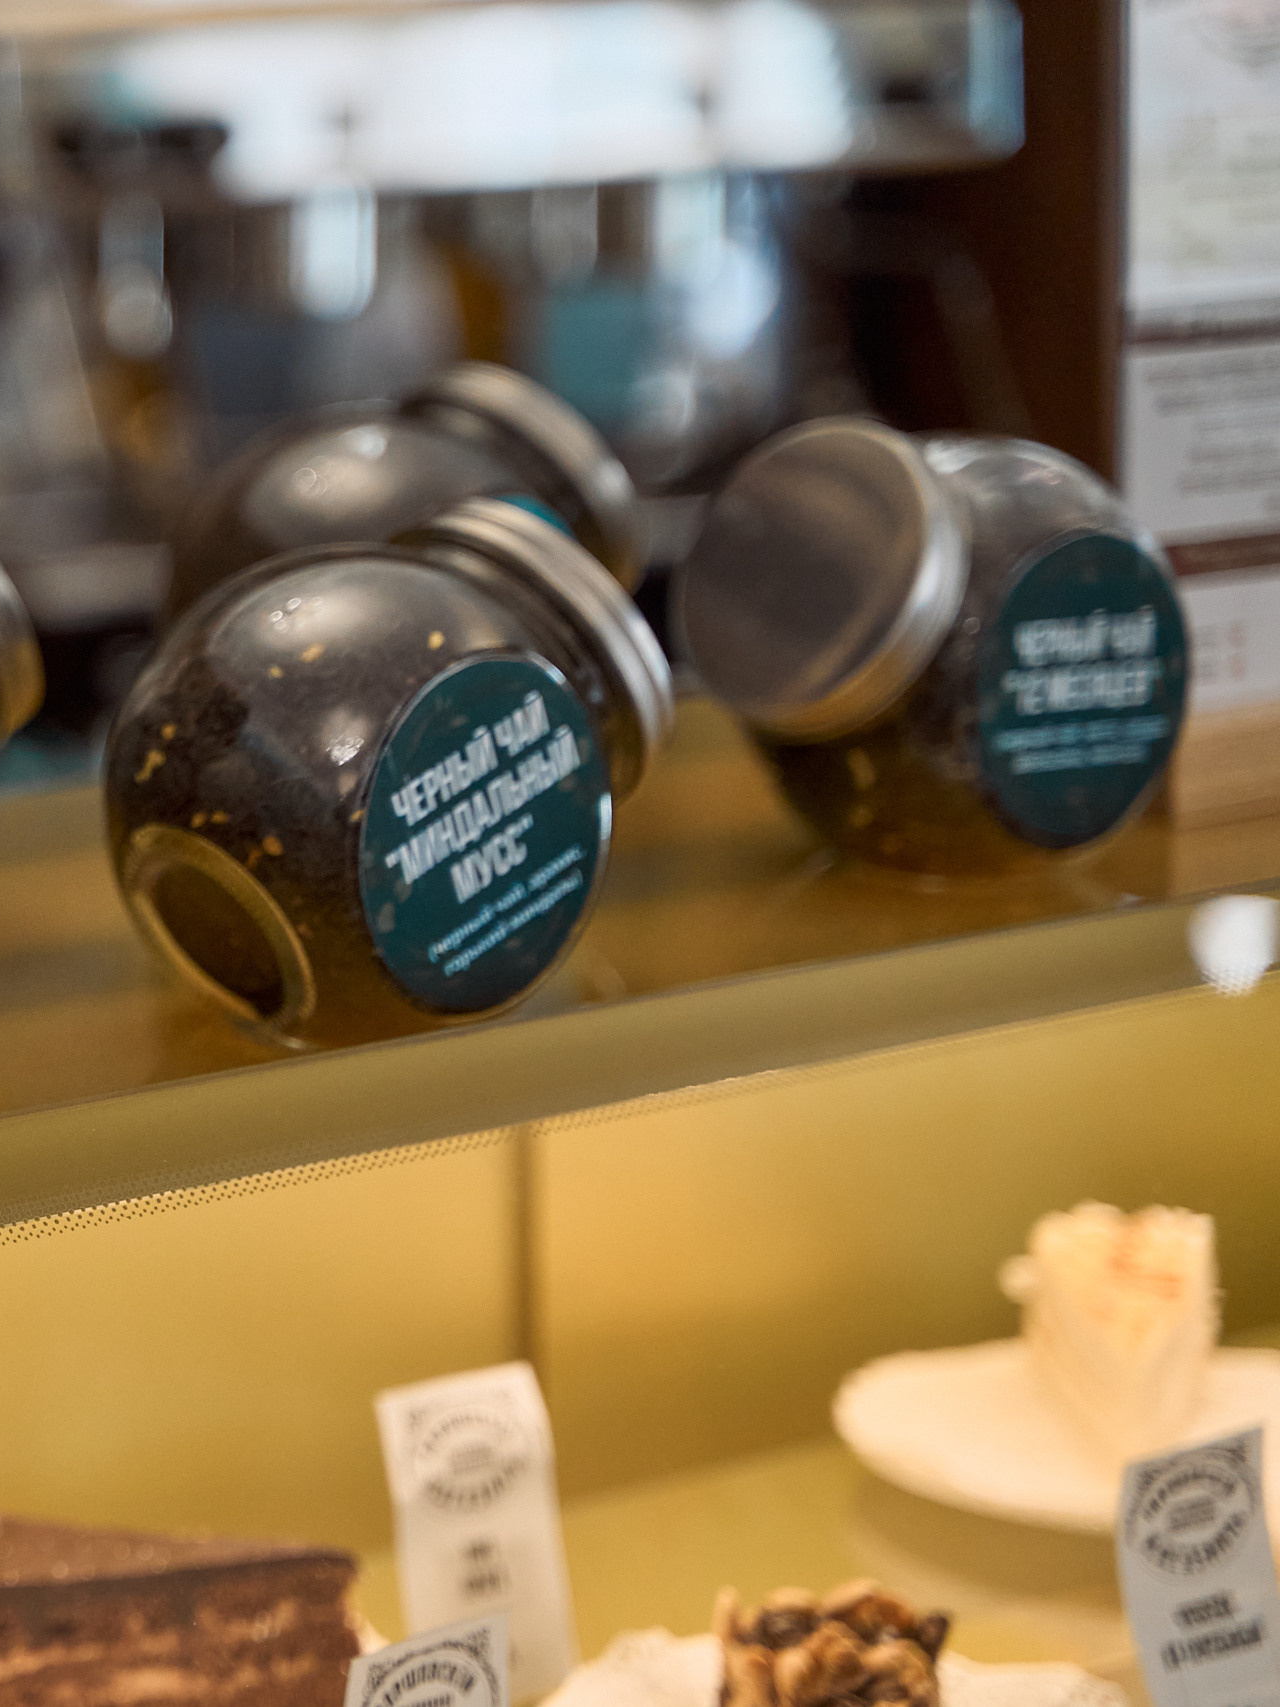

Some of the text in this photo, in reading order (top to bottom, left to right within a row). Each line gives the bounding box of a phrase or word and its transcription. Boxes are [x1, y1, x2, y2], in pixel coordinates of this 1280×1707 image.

[385, 723, 580, 885] "МИНДАЛЬНЫЙ
[390, 689, 550, 827] ЧЕРНЫЙ ЧАЙ
[450, 812, 533, 904] МУСС"
